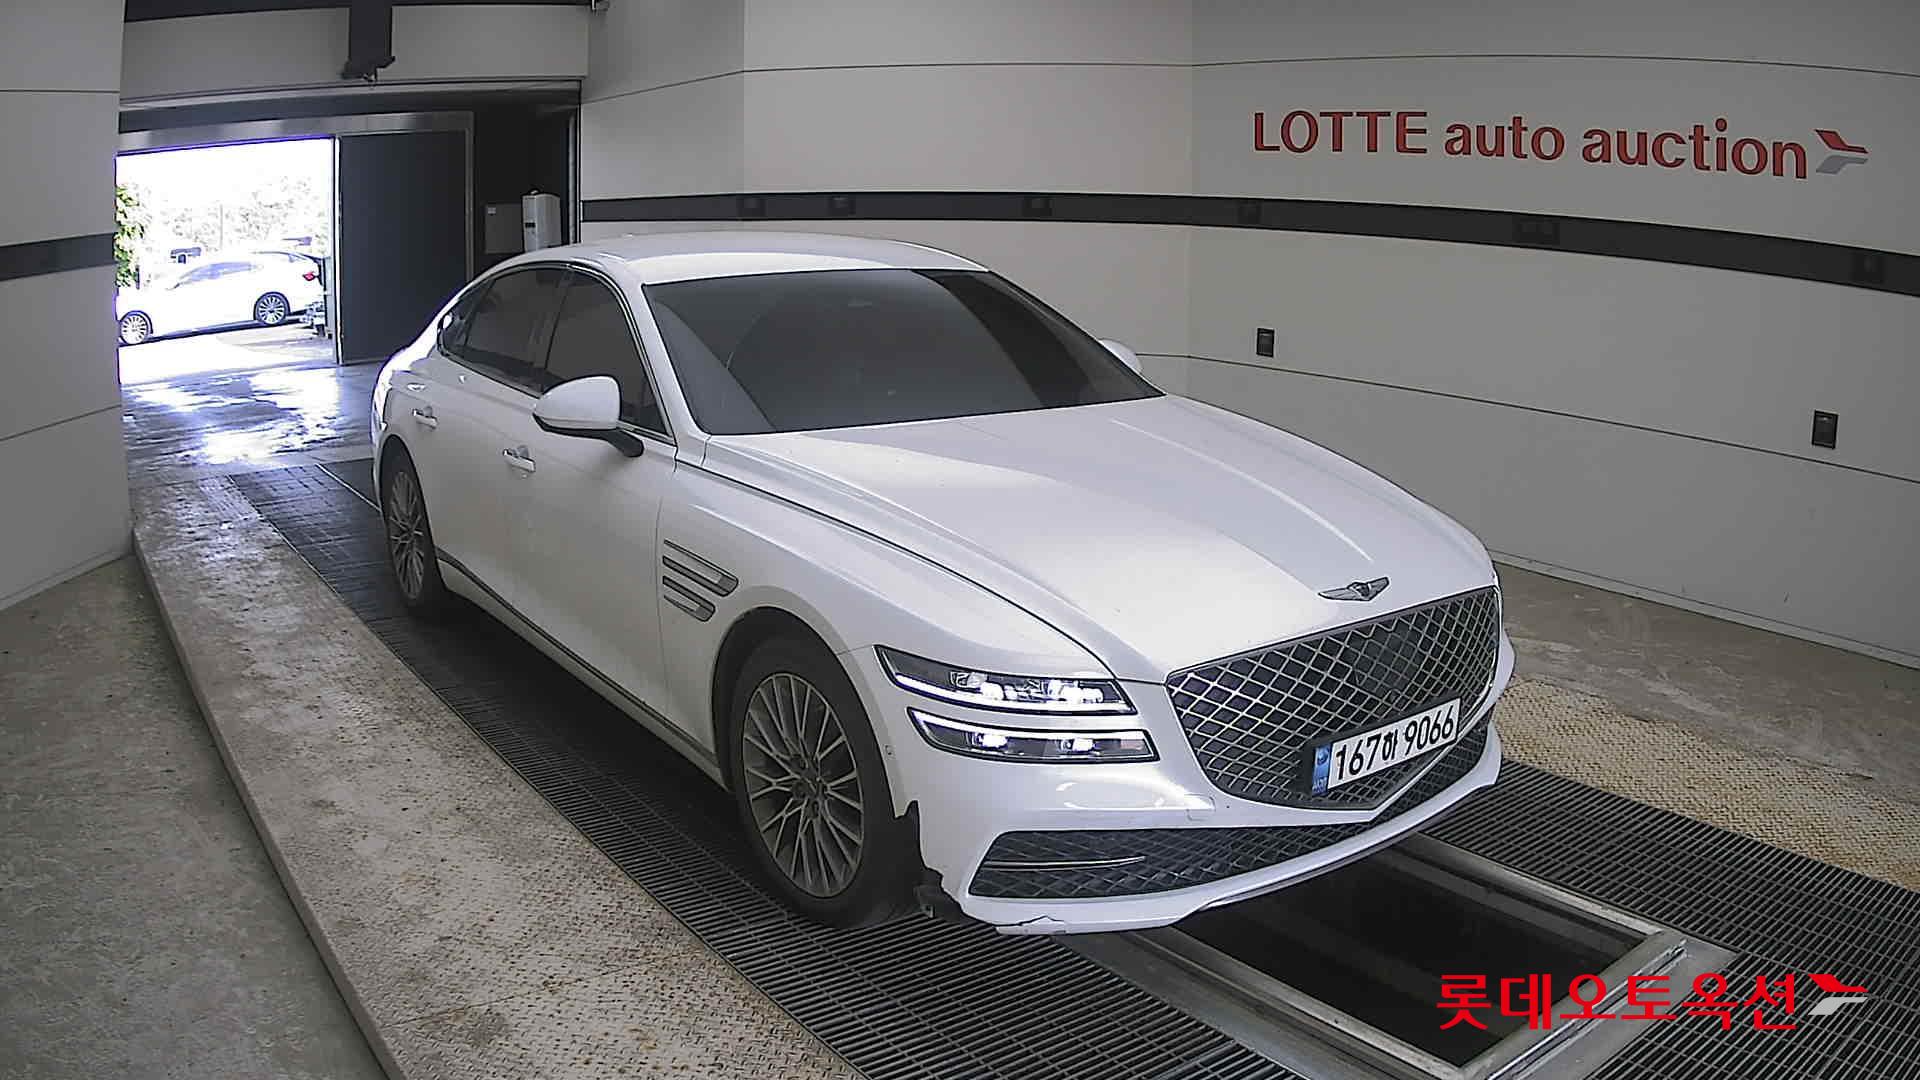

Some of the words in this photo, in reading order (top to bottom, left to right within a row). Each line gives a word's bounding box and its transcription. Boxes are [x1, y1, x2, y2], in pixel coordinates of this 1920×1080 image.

[1254, 111, 1428, 154] LOTTE
[1444, 116, 1566, 161] auto
[1582, 118, 1808, 180] auction
[1335, 728, 1399, 780] 167하
[1404, 704, 1454, 756] 9066
